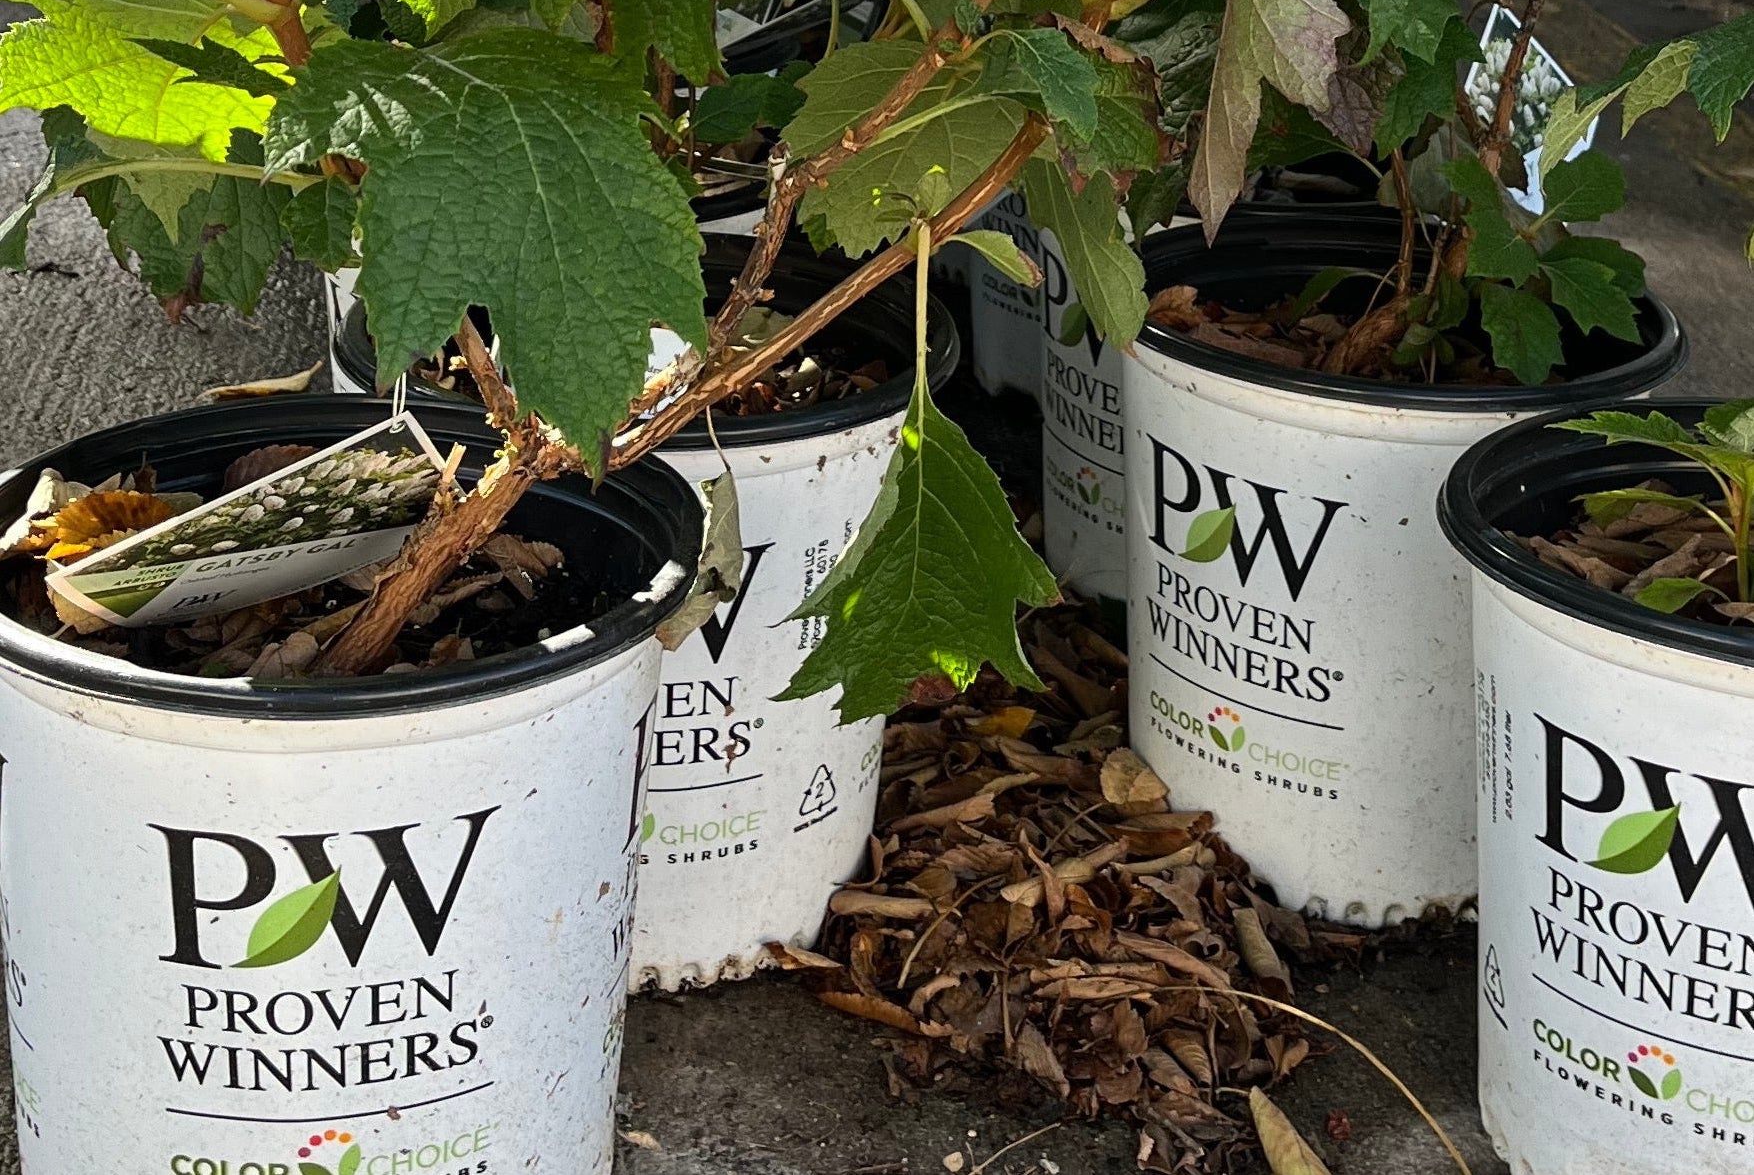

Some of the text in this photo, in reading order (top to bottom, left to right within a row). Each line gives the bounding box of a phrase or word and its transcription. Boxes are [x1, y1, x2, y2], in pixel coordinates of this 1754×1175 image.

[1046, 347, 1121, 415] PROVE
[1146, 432, 1350, 603] PW
[136, 564, 185, 576] SHRUB
[196, 547, 303, 573] GATSBY
[1156, 560, 1316, 655] PROVEN
[1150, 690, 1343, 781] COLOR CHOICE
[1150, 716, 1339, 800] FLOWERING SHRUBS
[659, 811, 763, 846] CHOICE
[667, 839, 759, 864] SHRUBS
[146, 804, 502, 969] PW
[181, 970, 460, 1036] PROVEN
[1530, 905, 1754, 1031] WINNER
[1533, 1018, 1754, 1123] COLOR CHO
[1533, 1051, 1754, 1146] FLOWERING SHR
[367, 1127, 492, 1175] CHOICE
